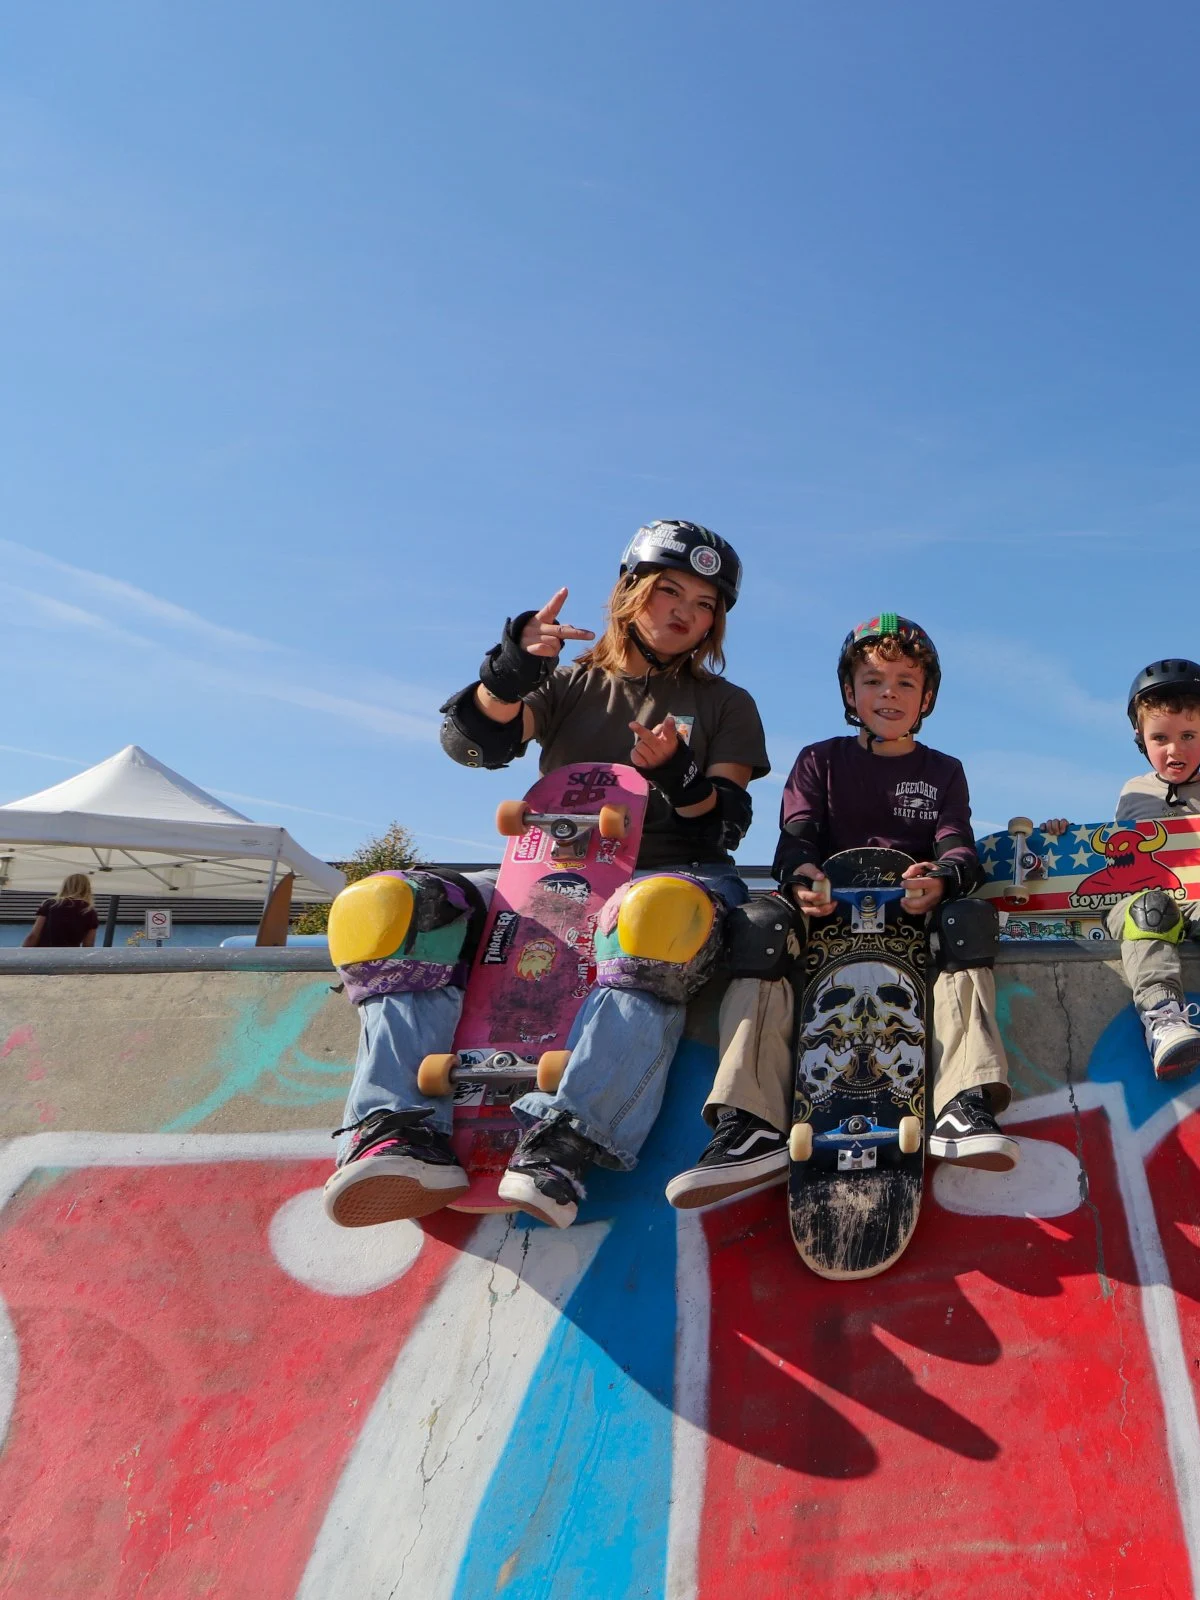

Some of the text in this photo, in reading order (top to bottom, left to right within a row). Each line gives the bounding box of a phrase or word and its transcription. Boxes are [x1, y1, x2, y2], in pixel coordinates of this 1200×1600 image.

[895, 781, 938, 800] LEGENDARY
[893, 807, 916, 818] SKATE
[919, 811, 939, 820] CREW
[484, 911, 517, 963] THRASER
